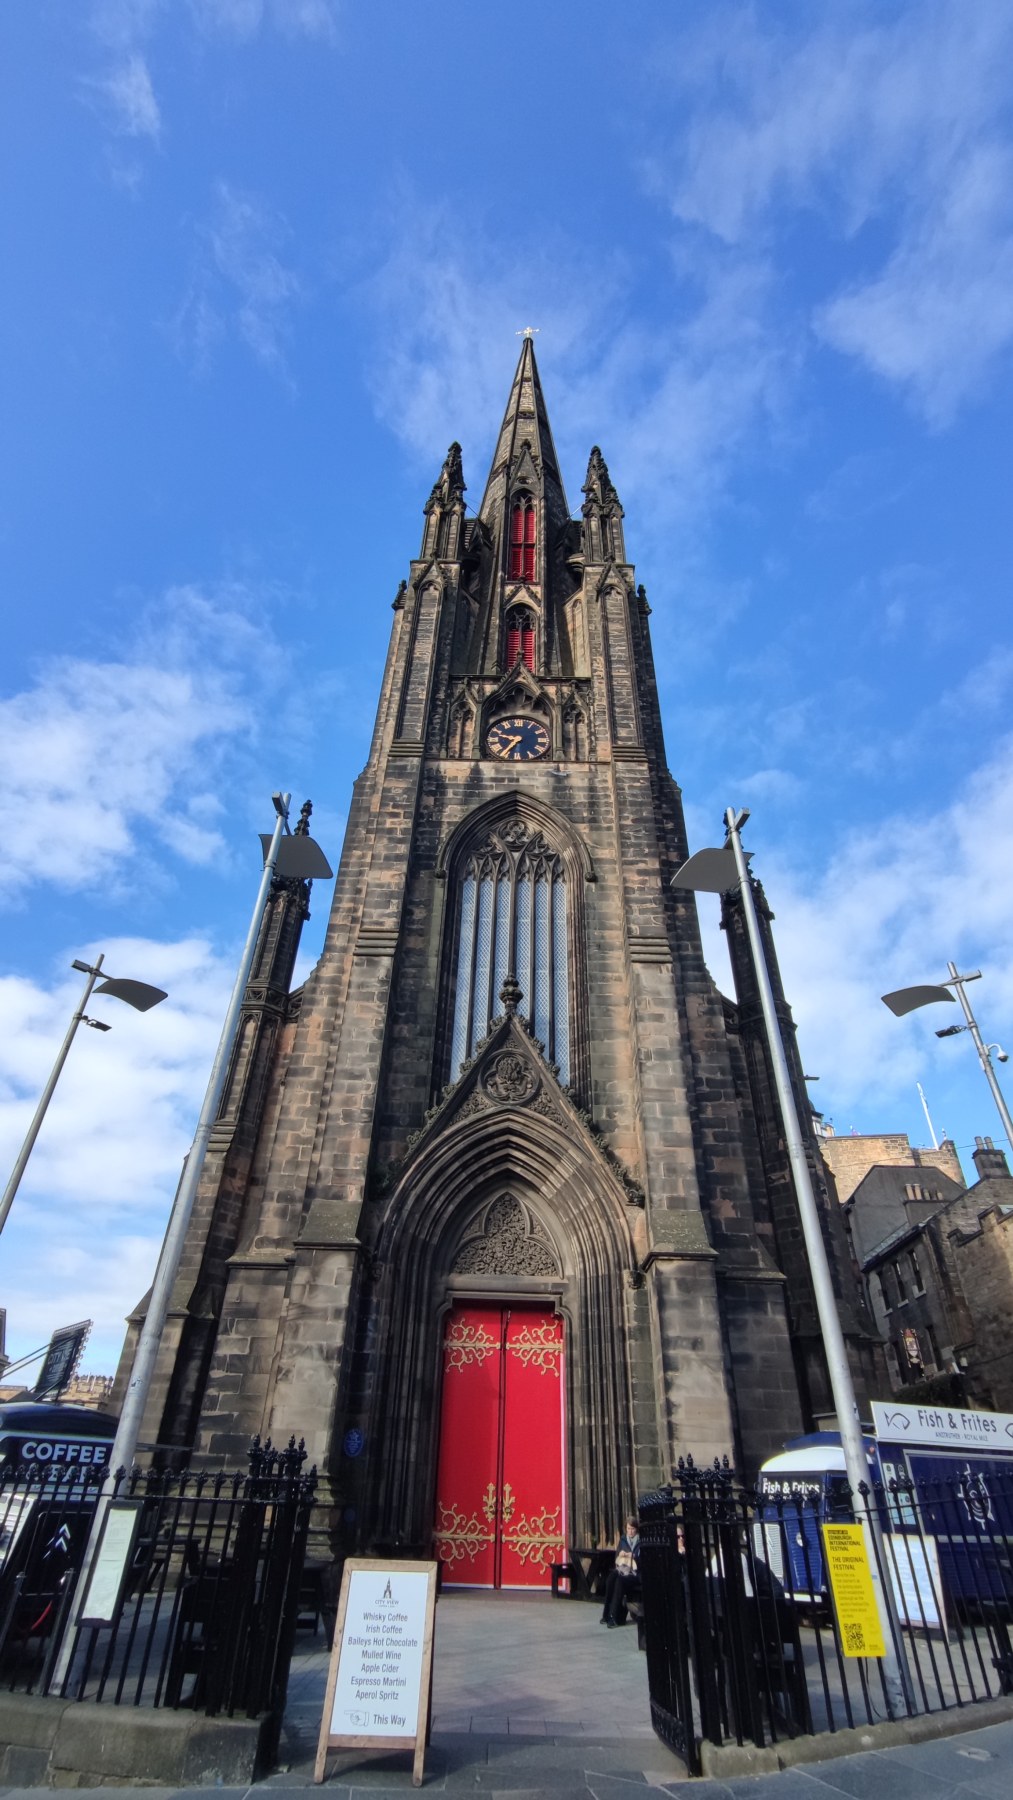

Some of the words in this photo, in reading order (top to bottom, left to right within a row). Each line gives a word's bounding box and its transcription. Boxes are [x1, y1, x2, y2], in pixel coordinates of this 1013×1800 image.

[514, 719, 523, 727] XII
[917, 1409, 944, 1428] Fish
[947, 1412, 958, 1429] &
[960, 1413, 997, 1433] Frites
[22, 1441, 107, 1464] COFFEE
[762, 1481, 780, 1494] Fish
[782, 1481, 791, 1494] &
[363, 1612, 387, 1623] Whisky
[387, 1612, 408, 1622] Coffee
[365, 1624, 380, 1633] Irish
[381, 1624, 403, 1634] Coffee
[347, 1636, 371, 1647] Baileys
[372, 1637, 385, 1646] Hot
[386, 1637, 418, 1647] Chocolate
[361, 1650, 384, 1659] Mulled
[385, 1650, 402, 1660] Wine
[361, 1663, 380, 1674] Apple
[381, 1663, 400, 1673] Cider
[350, 1676, 380, 1687] Espresso
[382, 1677, 407, 1687] Martini
[355, 1689, 378, 1701] Aperol
[378, 1690, 399, 1701] Spritz
[373, 1713, 389, 1725] This
[390, 1714, 406, 1727] Way
